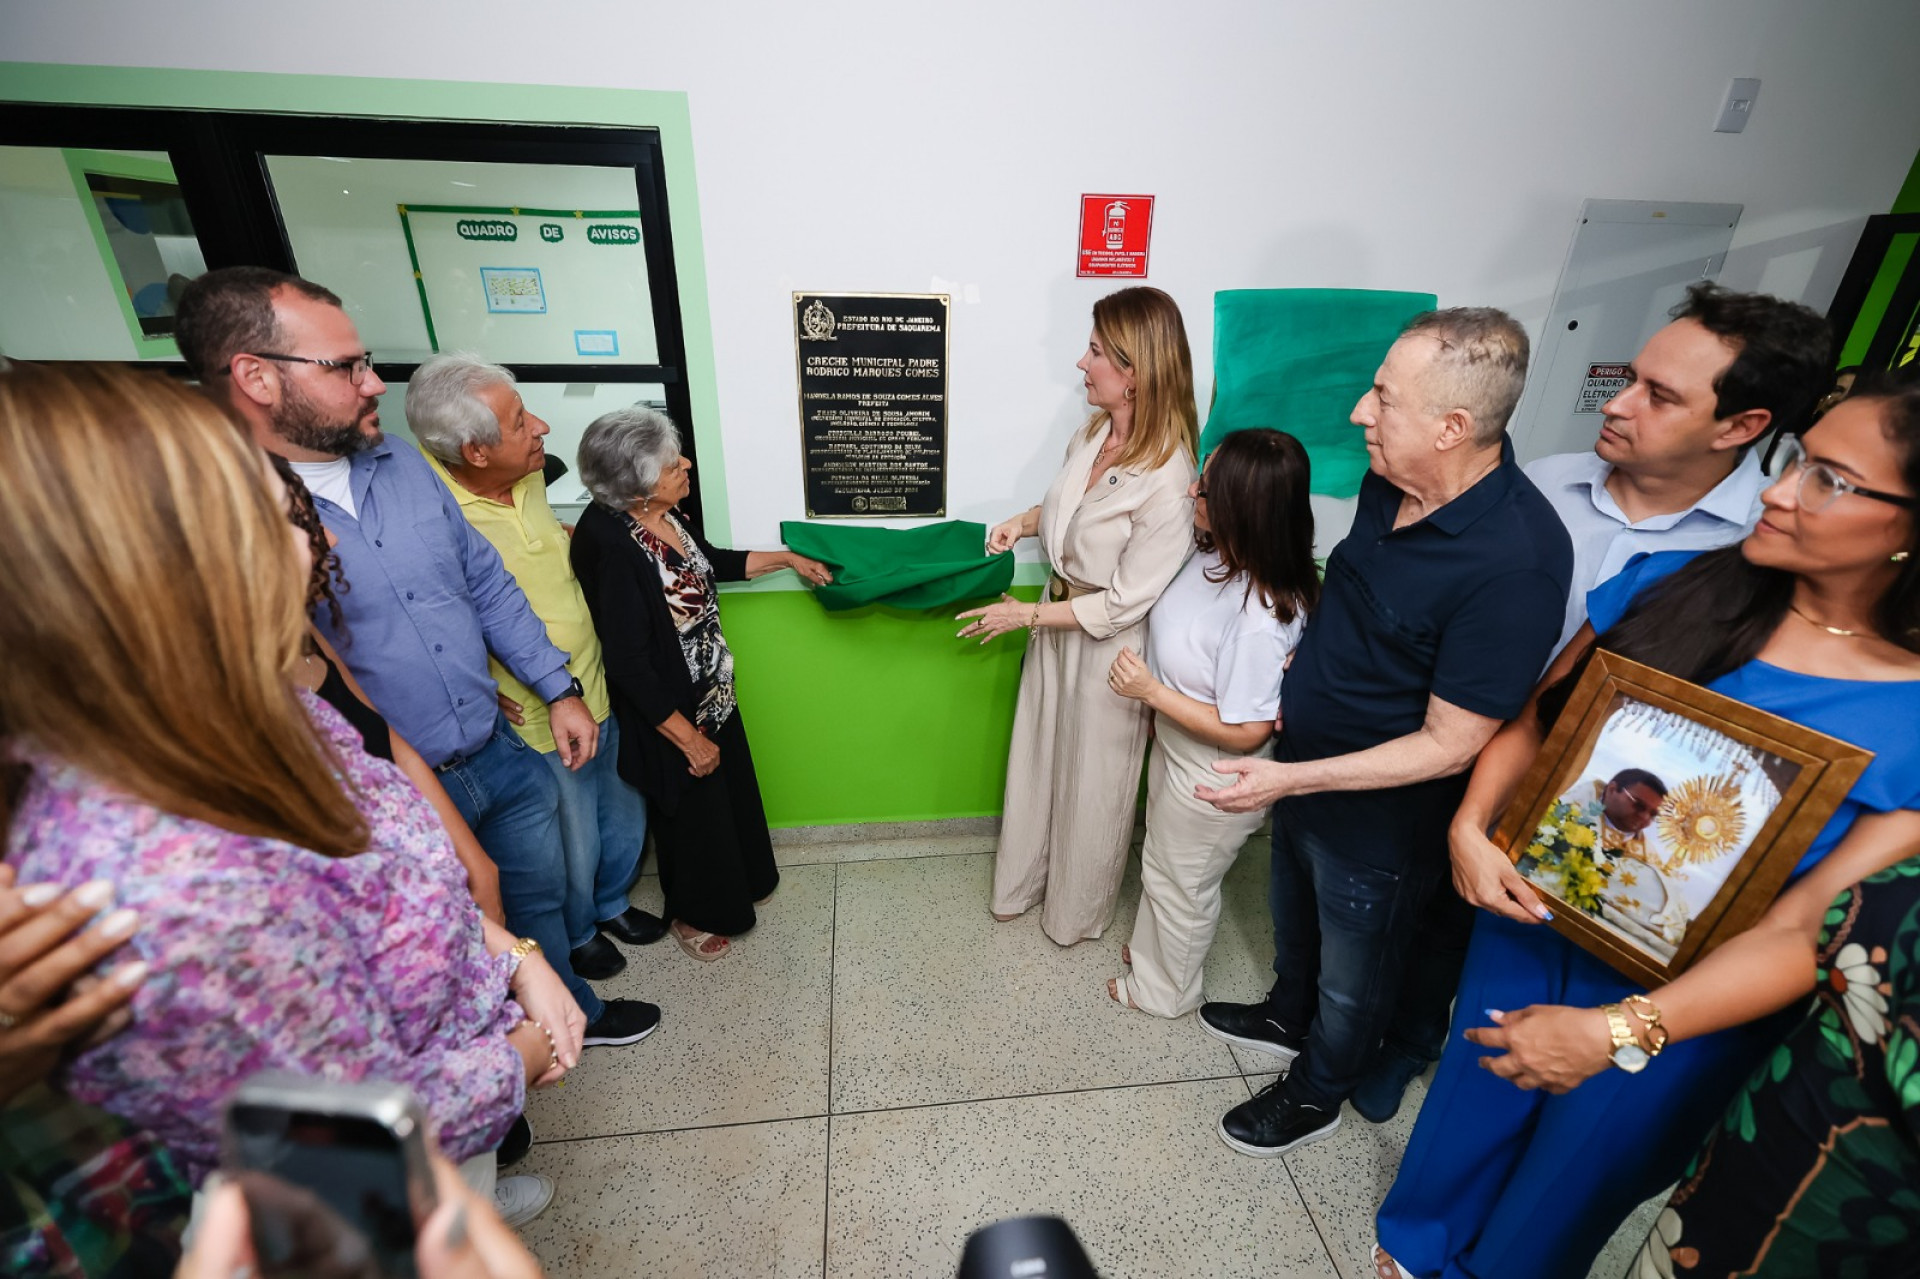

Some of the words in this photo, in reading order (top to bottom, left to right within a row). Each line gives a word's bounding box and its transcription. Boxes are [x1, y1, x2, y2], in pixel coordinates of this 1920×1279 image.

[459, 223, 515, 237] QUADRO
[542, 226, 561, 239] DE
[590, 228, 637, 240] AVISOS
[843, 315, 867, 323] ESTADO
[906, 316, 934, 324] JANEIRO
[837, 323, 885, 331] PREFEITURA
[886, 324, 896, 332] DE
[899, 324, 941, 332] SAQUAREMA
[807, 356, 848, 367] CRECHE
[851, 357, 905, 368] MUNICIPAL
[908, 358, 939, 368] PADRE
[806, 366, 850, 377] RODRIGO
[853, 367, 902, 378] MARQUES
[905, 368, 940, 379] GOMES
[1596, 367, 1623, 375] PERIGO
[1587, 379, 1624, 387] QUADRO
